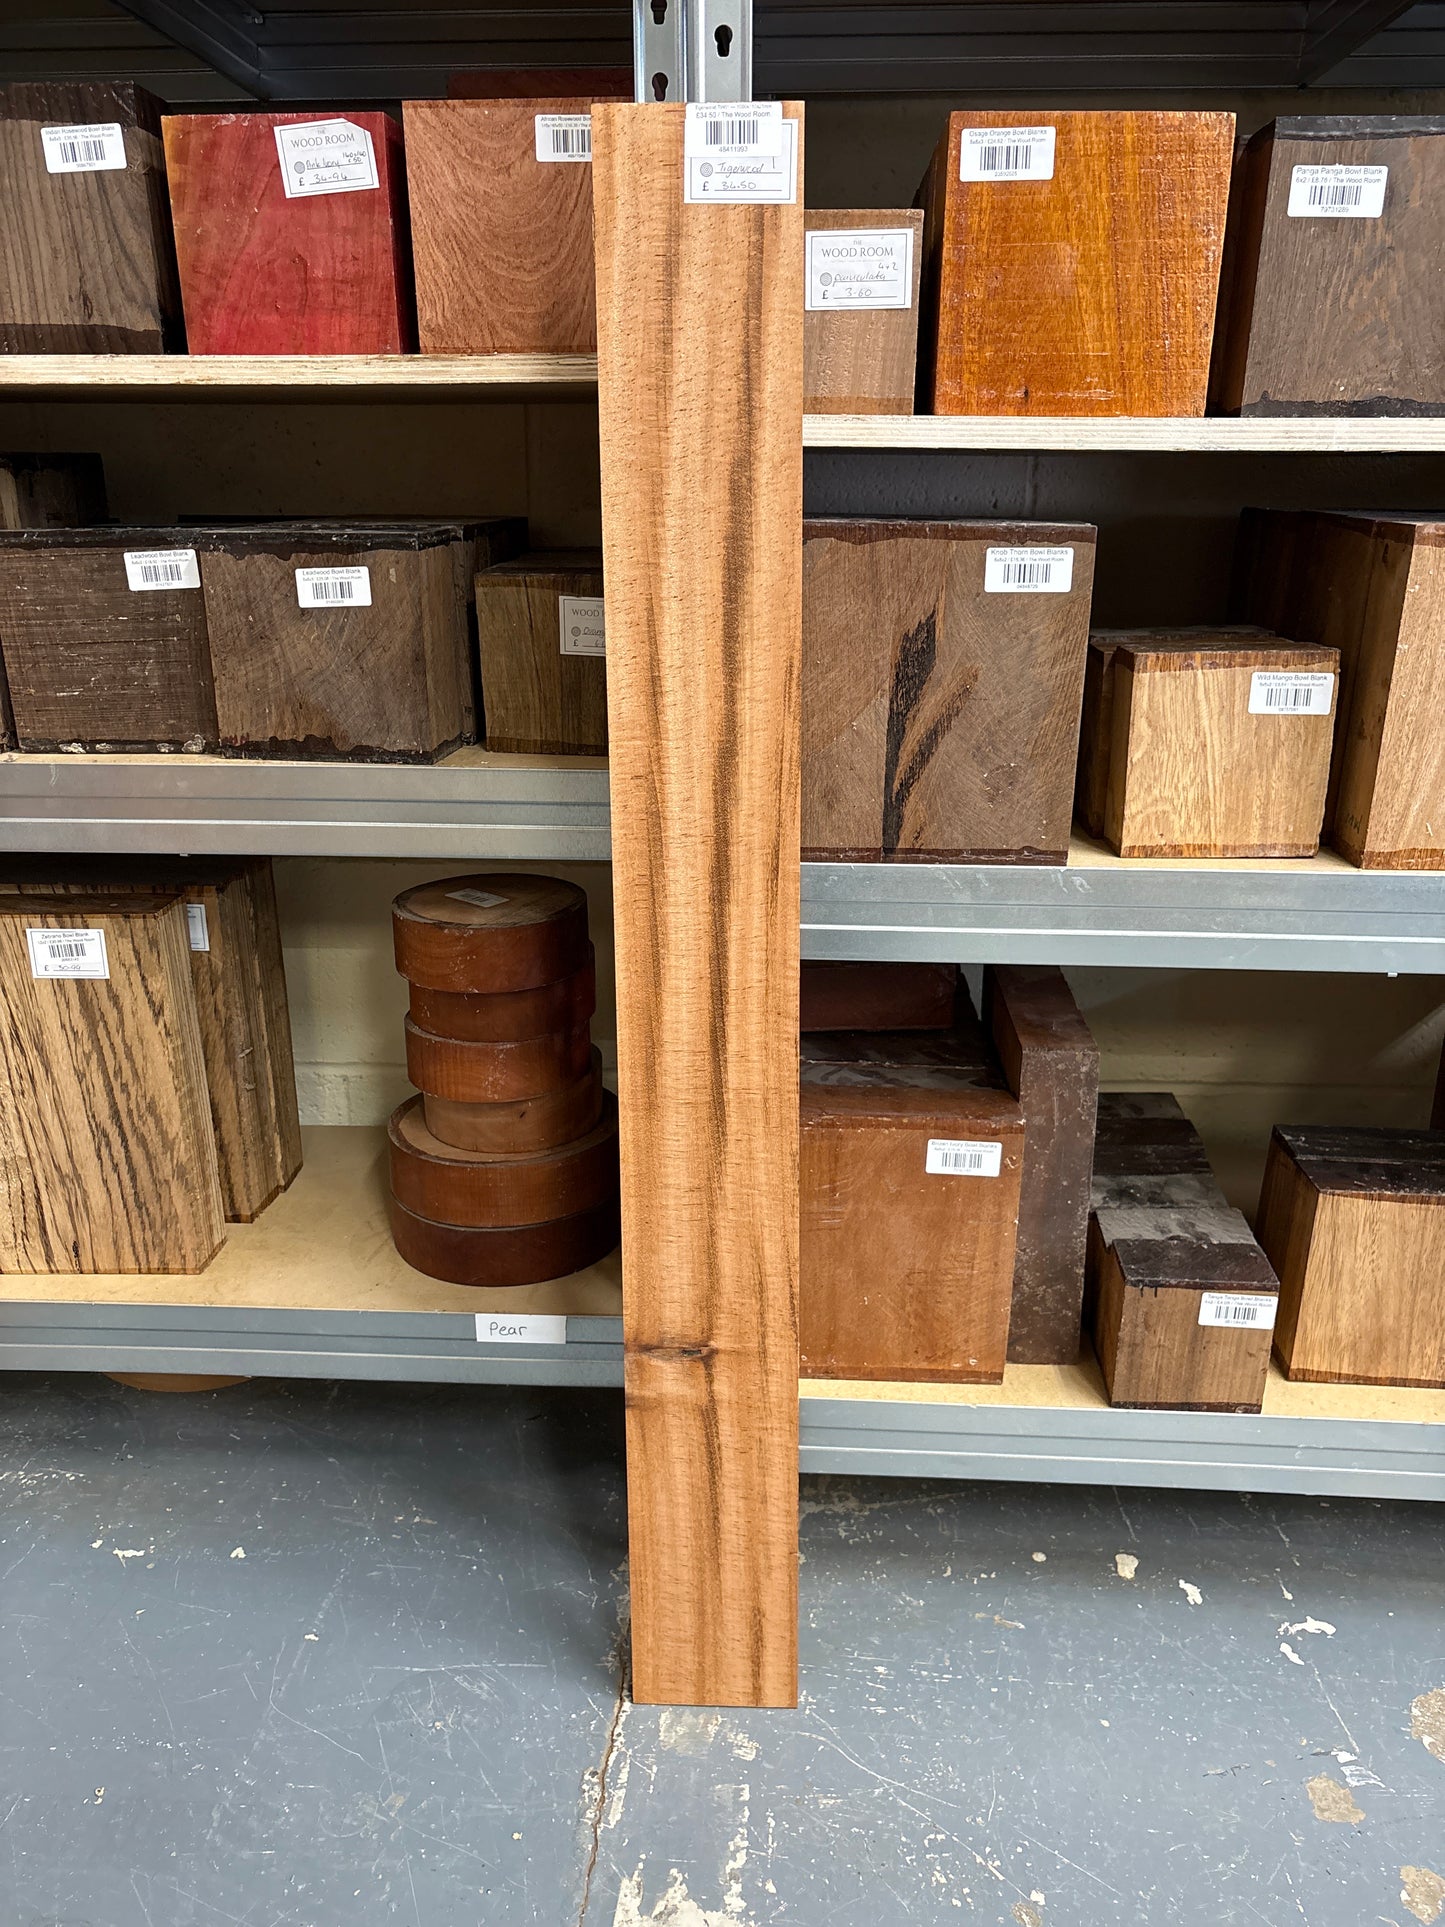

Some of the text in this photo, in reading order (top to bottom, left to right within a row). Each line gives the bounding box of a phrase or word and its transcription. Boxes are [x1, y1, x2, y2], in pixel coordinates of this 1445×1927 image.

[291, 133, 355, 148] WOOD ROOM
[1297, 167, 1319, 176] Panga
[1321, 167, 1343, 176] Panga
[299, 177, 305, 186] £
[702, 181, 709, 191] £
[822, 247, 893, 257] WOOD ROOM
[822, 290, 828, 299] £
[572, 609, 599, 617] WOOD
[489, 1321, 527, 1336] Pear
